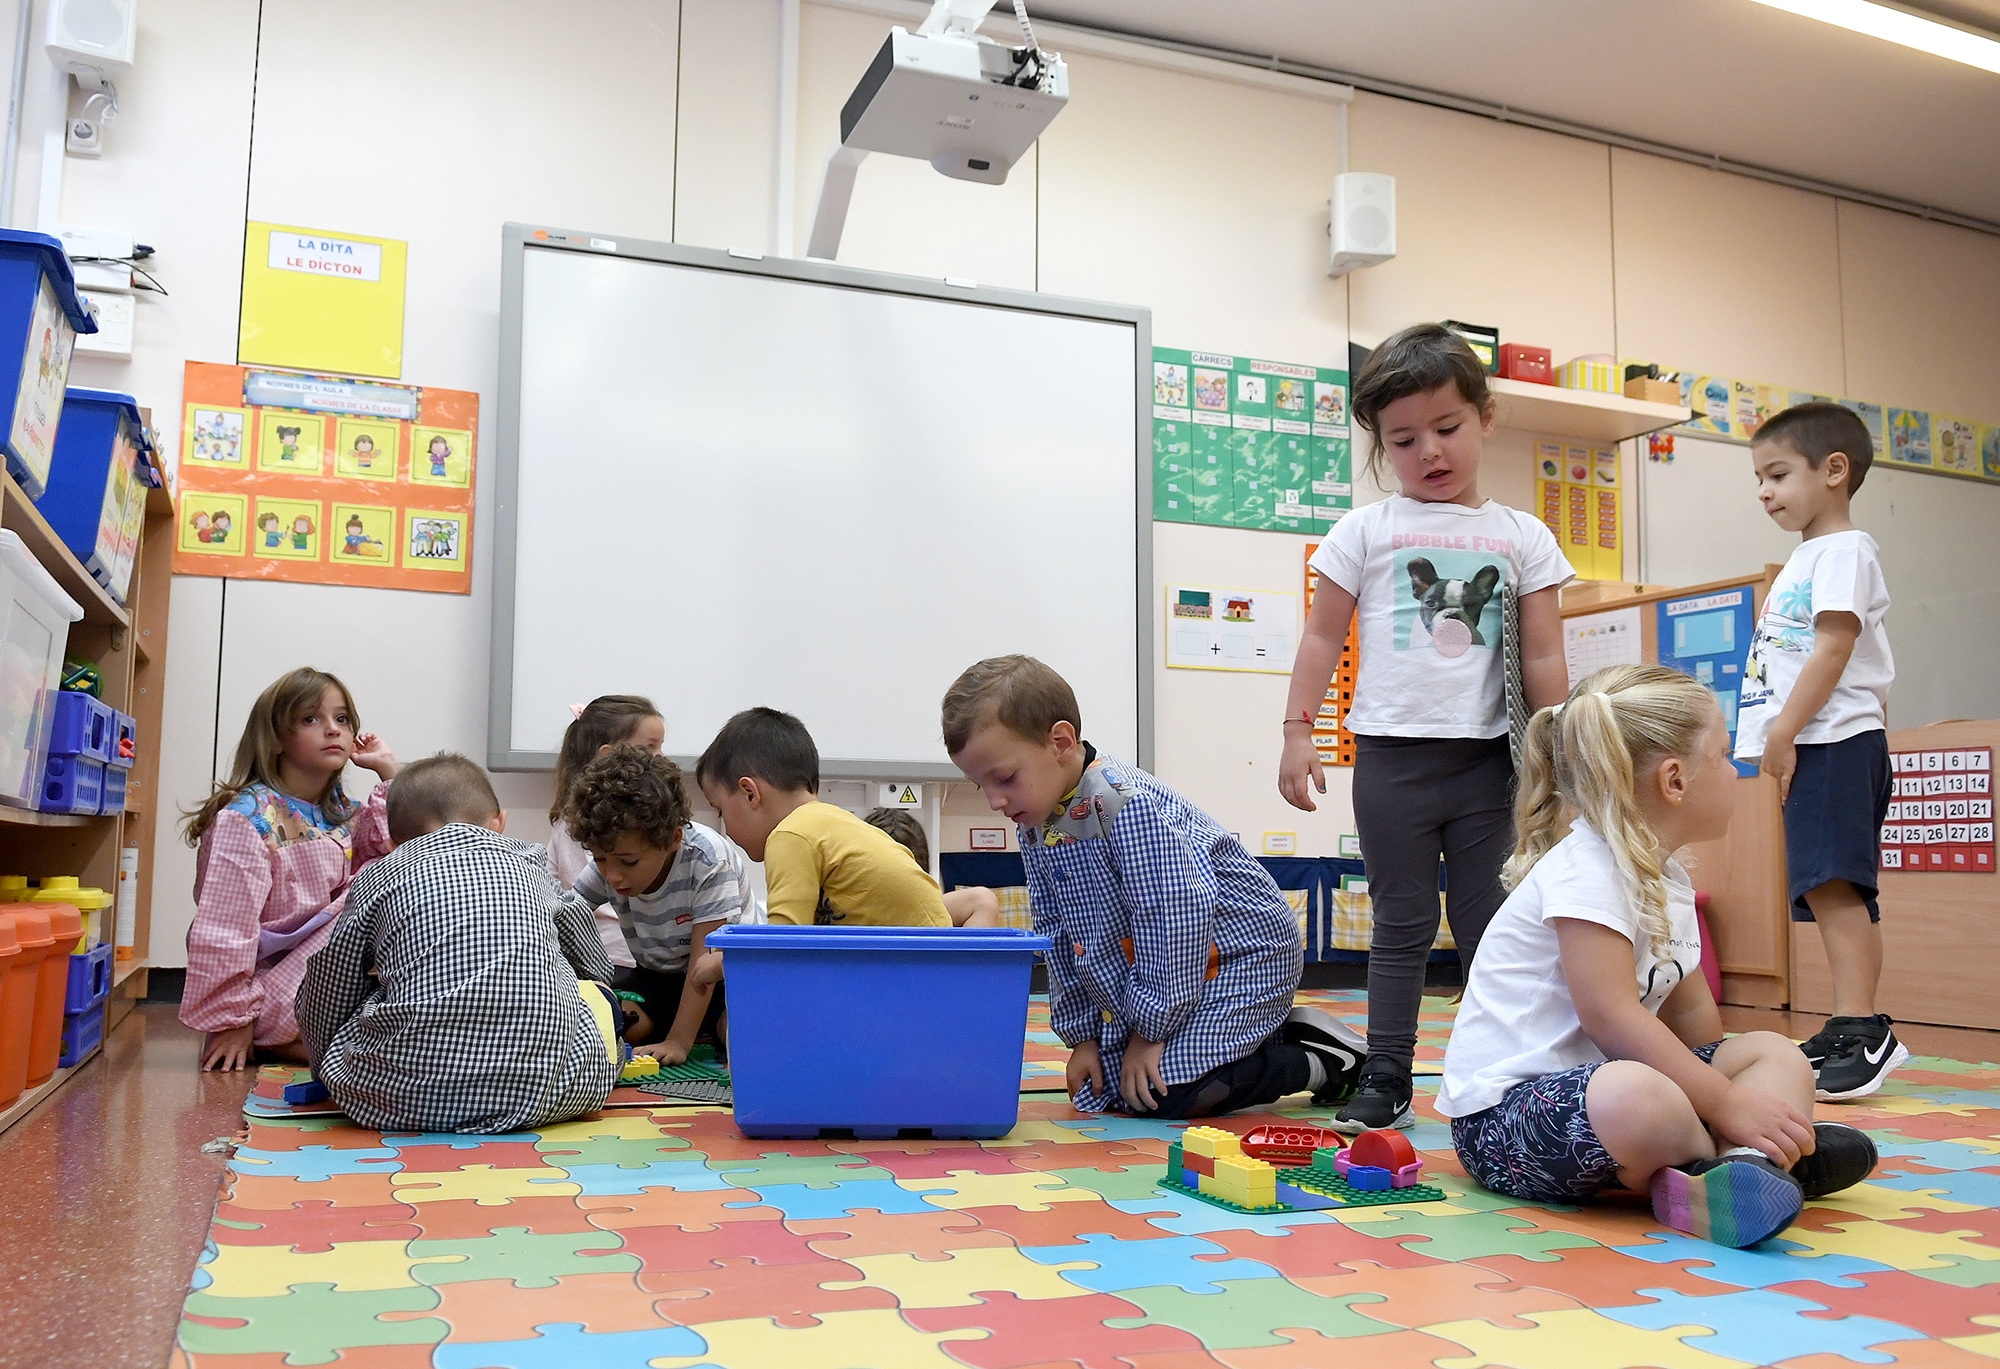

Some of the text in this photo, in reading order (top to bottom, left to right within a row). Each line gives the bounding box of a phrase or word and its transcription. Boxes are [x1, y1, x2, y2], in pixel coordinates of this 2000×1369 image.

[298, 239, 315, 250] LA
[286, 257, 303, 268] LE
[1252, 362, 1314, 377] RESPONSABLES
[266, 380, 300, 390] NORMES
[311, 398, 345, 408] NORMES
[359, 402, 370, 410] LA
[372, 404, 402, 414] CLASSE
[1392, 534, 1511, 556] BUBBLE FUN
[1720, 594, 1739, 604] DATE
[1906, 755, 1981, 768] 4 5 6 7
[1905, 782, 1918, 792] 11
[1926, 780, 1941, 792] 12
[1948, 779, 1963, 790] 13
[1971, 778, 1985, 789] 14
[1906, 804, 1919, 816] 18
[1927, 805, 1941, 816] 19
[1950, 804, 1964, 815] 20
[1973, 803, 1986, 814] 21
[1884, 827, 1988, 840] 24 25 26 27 28
[1885, 853, 1898, 864] 31
